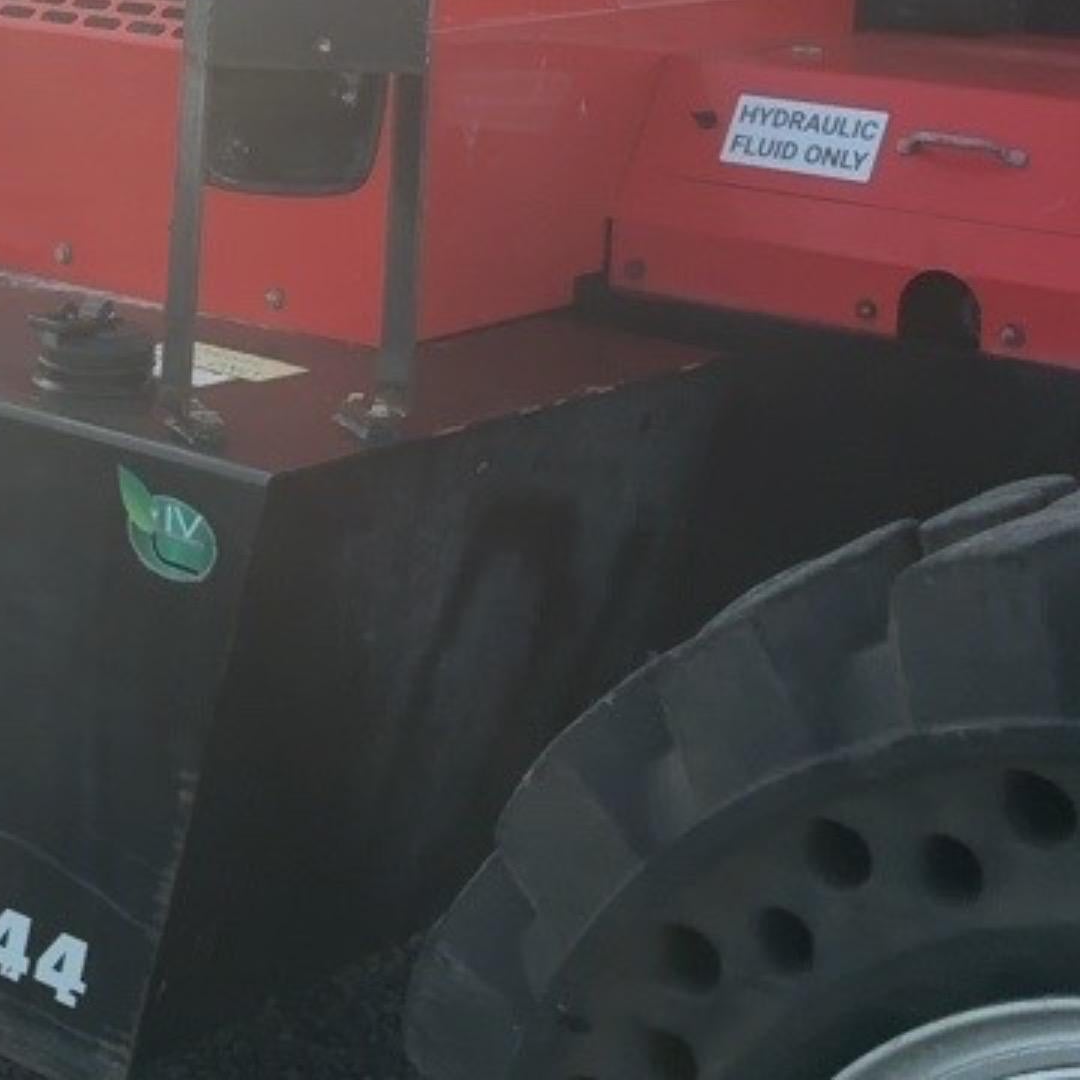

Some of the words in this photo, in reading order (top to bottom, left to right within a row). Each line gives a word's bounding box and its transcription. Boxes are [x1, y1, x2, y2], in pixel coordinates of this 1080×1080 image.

[739, 104, 880, 141] HYDRAULIC
[729, 134, 799, 160] FLUID
[804, 143, 870, 171] ONLY
